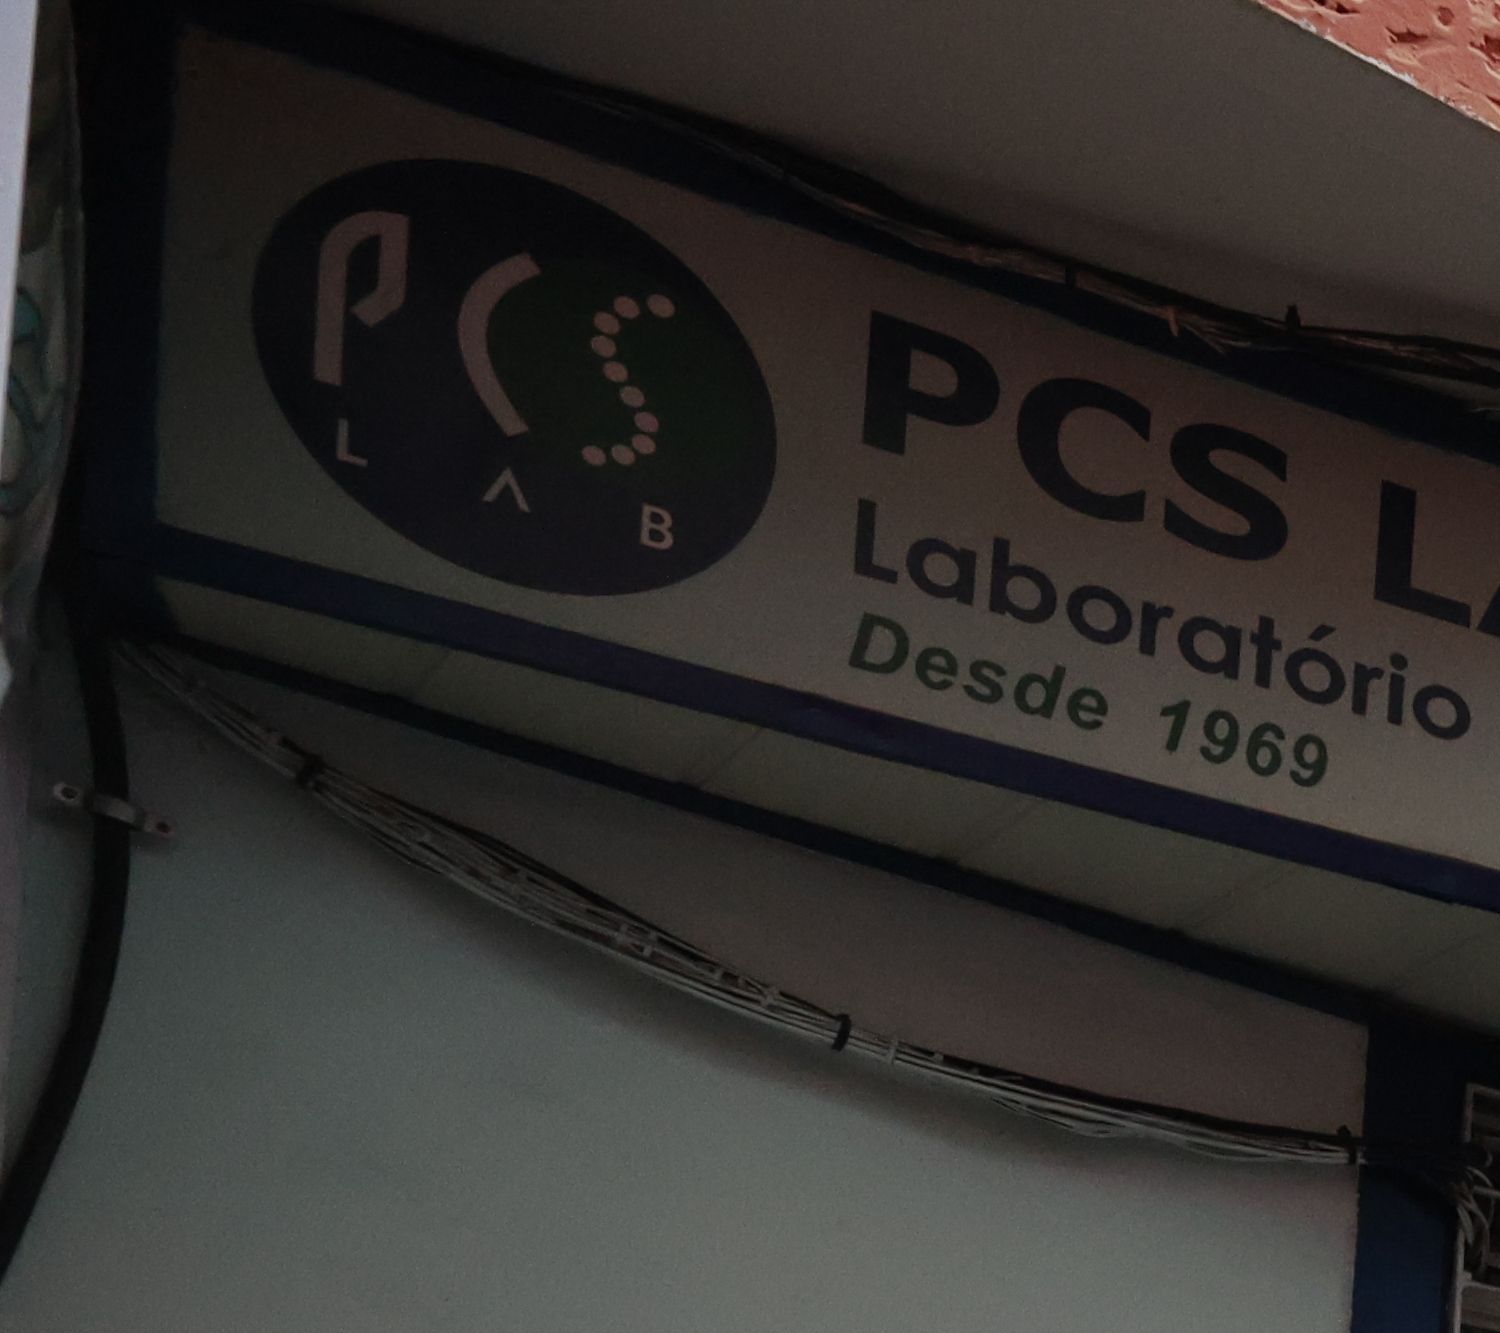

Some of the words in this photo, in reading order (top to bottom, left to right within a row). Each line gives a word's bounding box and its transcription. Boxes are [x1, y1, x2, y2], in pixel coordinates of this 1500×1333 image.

[313, 210, 676, 467] PCS
[861, 308, 1290, 563] PCS
[336, 419, 675, 552] LAB
[848, 612, 1108, 731] Desde
[1157, 698, 1329, 789] 1969
[851, 496, 1472, 742] Laboratório
